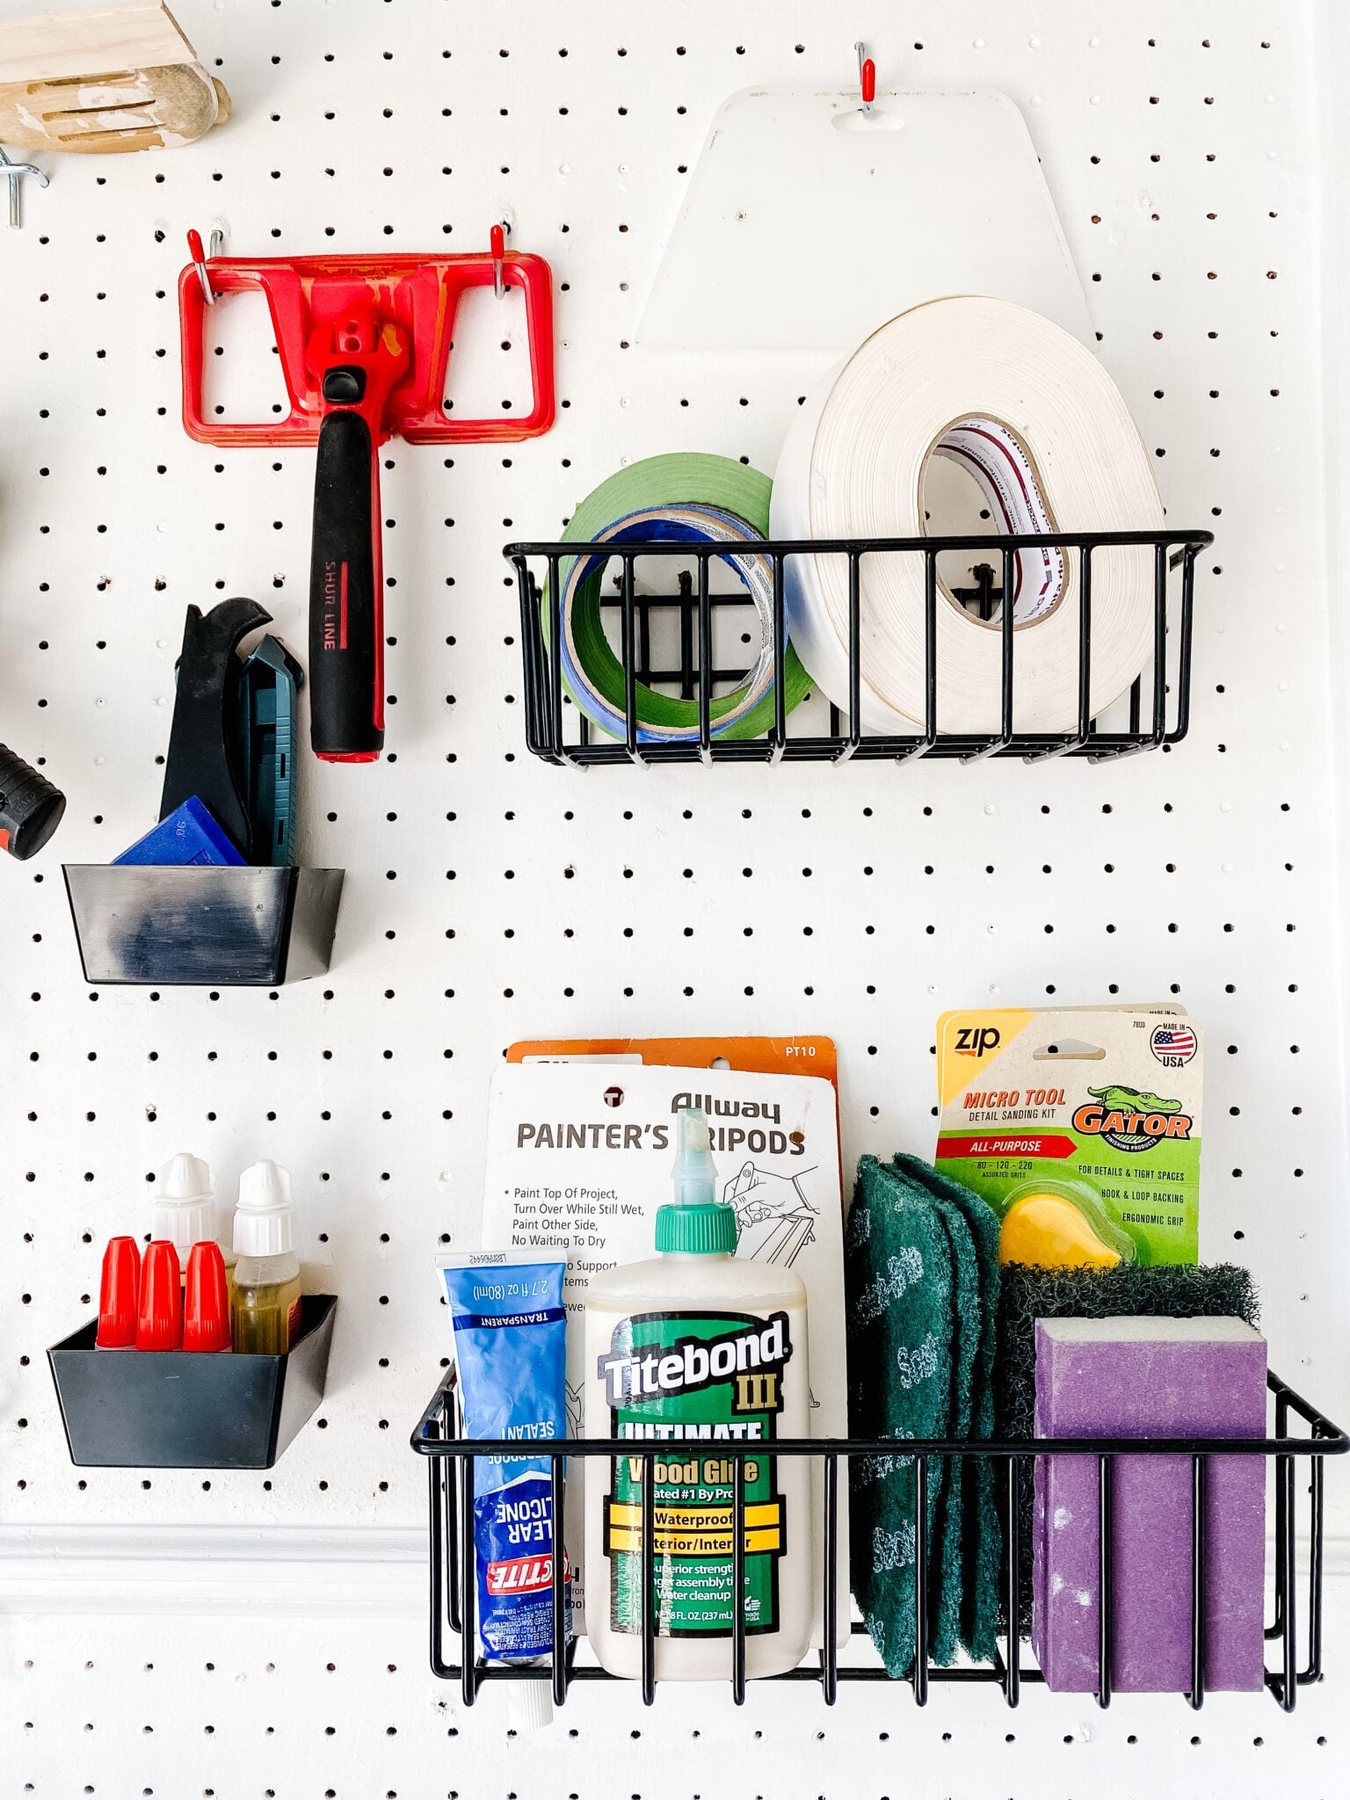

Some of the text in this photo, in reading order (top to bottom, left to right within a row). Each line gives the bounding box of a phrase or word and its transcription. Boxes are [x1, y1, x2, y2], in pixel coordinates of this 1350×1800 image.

[1163, 1023, 1178, 1031] MADE
[785, 1046, 817, 1057] PT10
[1163, 1056, 1184, 1068] USA
[963, 1088, 1066, 1109] MICRO TOOL
[969, 1108, 1056, 1122] DETAIL SANDING KIT
[1073, 1105, 1191, 1138] GATOR
[517, 1123, 669, 1150] PAINTER'S
[1105, 1134, 1157, 1150] FINISHING PRODUCTS
[970, 1140, 1042, 1152] ALL-PURPOSE
[977, 1161, 987, 1169] 80
[996, 1161, 1009, 1169] 120
[1018, 1161, 1033, 1170] 220
[1010, 1171, 1026, 1179] GRITS
[1078, 1165, 1185, 1181] FOR DETAILS & TIGHT SPACES
[514, 1187, 618, 1201] Paint Top Of Project,
[1101, 1189, 1184, 1204] HOOK & LOOP BACKING
[513, 1203, 645, 1216] Turn Over While Still Wet,
[512, 1219, 598, 1231] Paint Other Side,
[1122, 1212, 1184, 1226] ERGONOMIC GRIP
[512, 1234, 606, 1249] No Waiting To Dry
[566, 1260, 618, 1273] o Support
[564, 1277, 589, 1287] tems
[473, 1280, 548, 1301] 2.7 fl oz (80ml)
[481, 1312, 549, 1327] TRANSPARENT
[605, 1319, 786, 1400] Titebond
[736, 1373, 777, 1410] III
[653, 1489, 680, 1500] ated
[681, 1489, 696, 1500] #1
[698, 1489, 714, 1502] By
[655, 1511, 733, 1528] Waterproof
[507, 1520, 552, 1544] LEAR
[491, 1560, 553, 1589] CTITE
[653, 1563, 693, 1576] uperior
[675, 1576, 723, 1589] assembly
[726, 1576, 751, 1586] tie
[689, 1589, 731, 1602] cleanup
